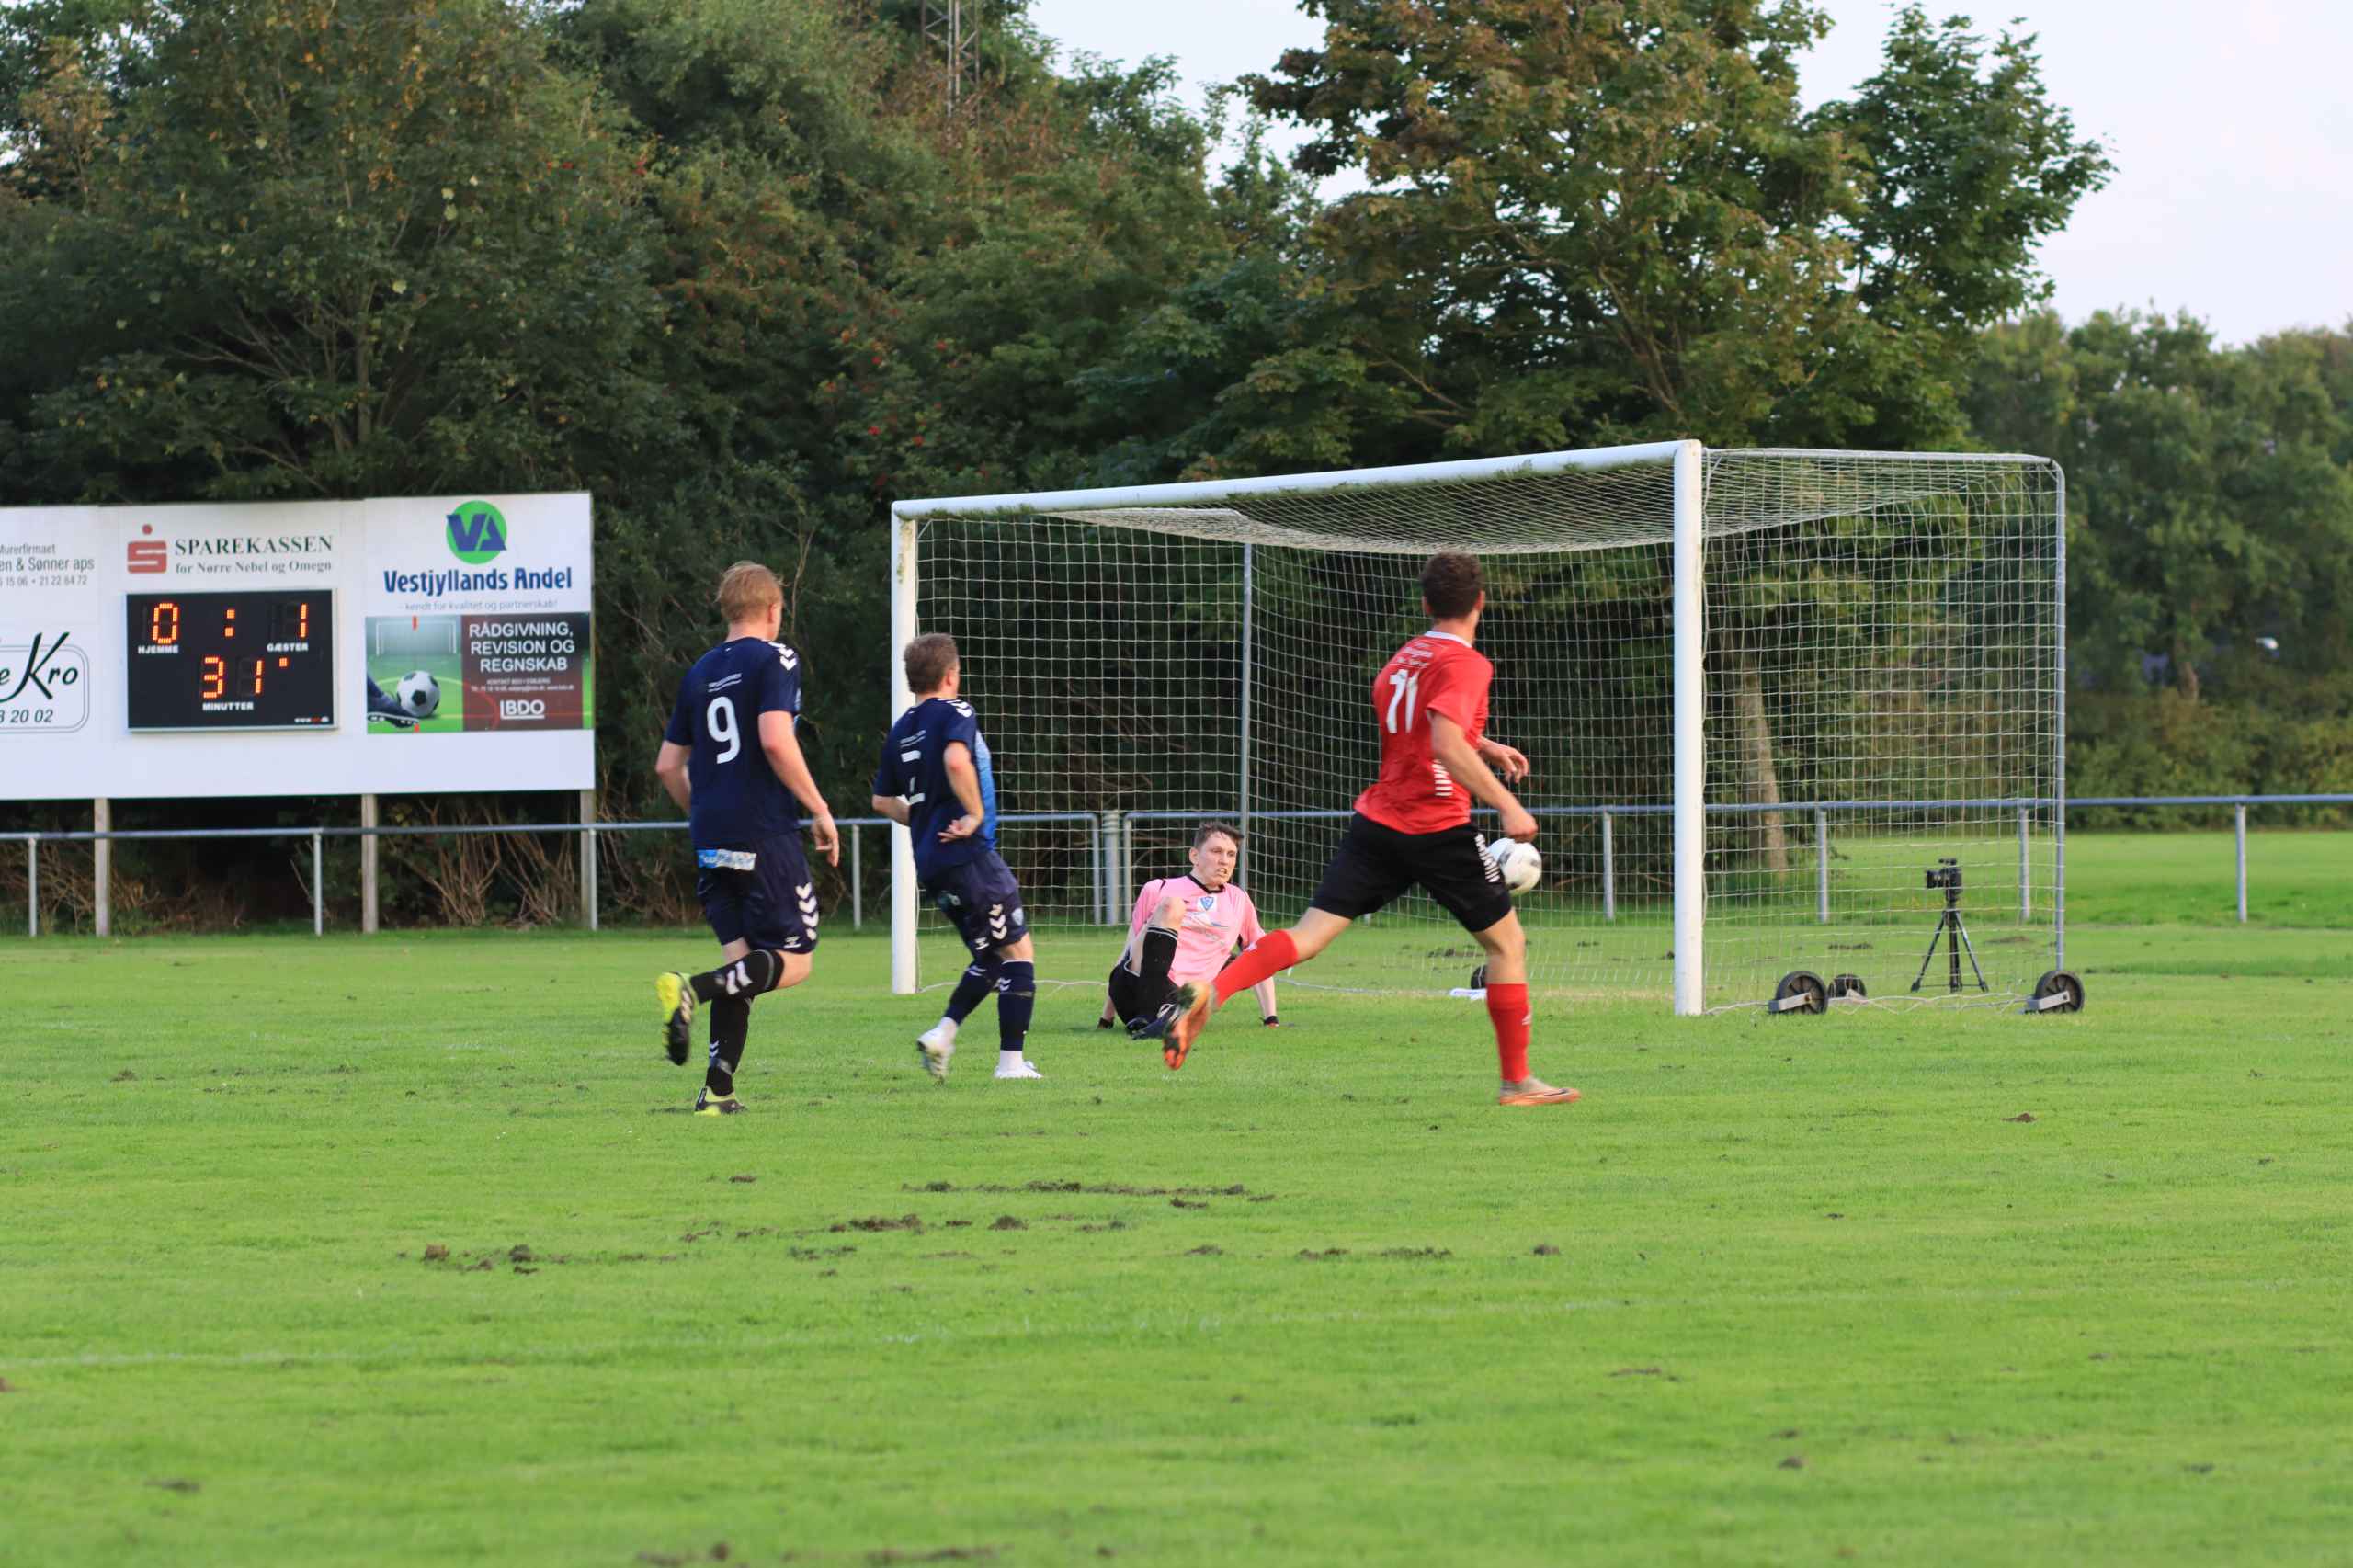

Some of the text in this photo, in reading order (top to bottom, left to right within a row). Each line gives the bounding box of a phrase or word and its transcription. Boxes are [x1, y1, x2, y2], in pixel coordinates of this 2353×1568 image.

[447, 513, 507, 551] VA
[176, 536, 333, 555] SPAREKASSEN
[17, 557, 24, 571] &
[28, 557, 69, 571] Sønner
[74, 558, 95, 573] aps
[176, 560, 332, 574] for Nørre Nebel og Omegn
[383, 567, 572, 597] Vestjyllands Andel
[448, 600, 483, 610] kvalitet
[153, 602, 179, 644] 0
[300, 603, 308, 638] 1
[469, 622, 574, 638] RÅDGIVNING,
[138, 642, 309, 653] HJEMME GÆSTER
[471, 639, 575, 655] REVISION OG
[0, 631, 78, 703] Kro
[480, 656, 568, 673] REGNSKAB
[202, 702, 254, 711] MINUTTER
[505, 699, 545, 715] BDO
[10, 709, 29, 723] 20
[34, 709, 53, 723] 02
[707, 696, 741, 764] 9
